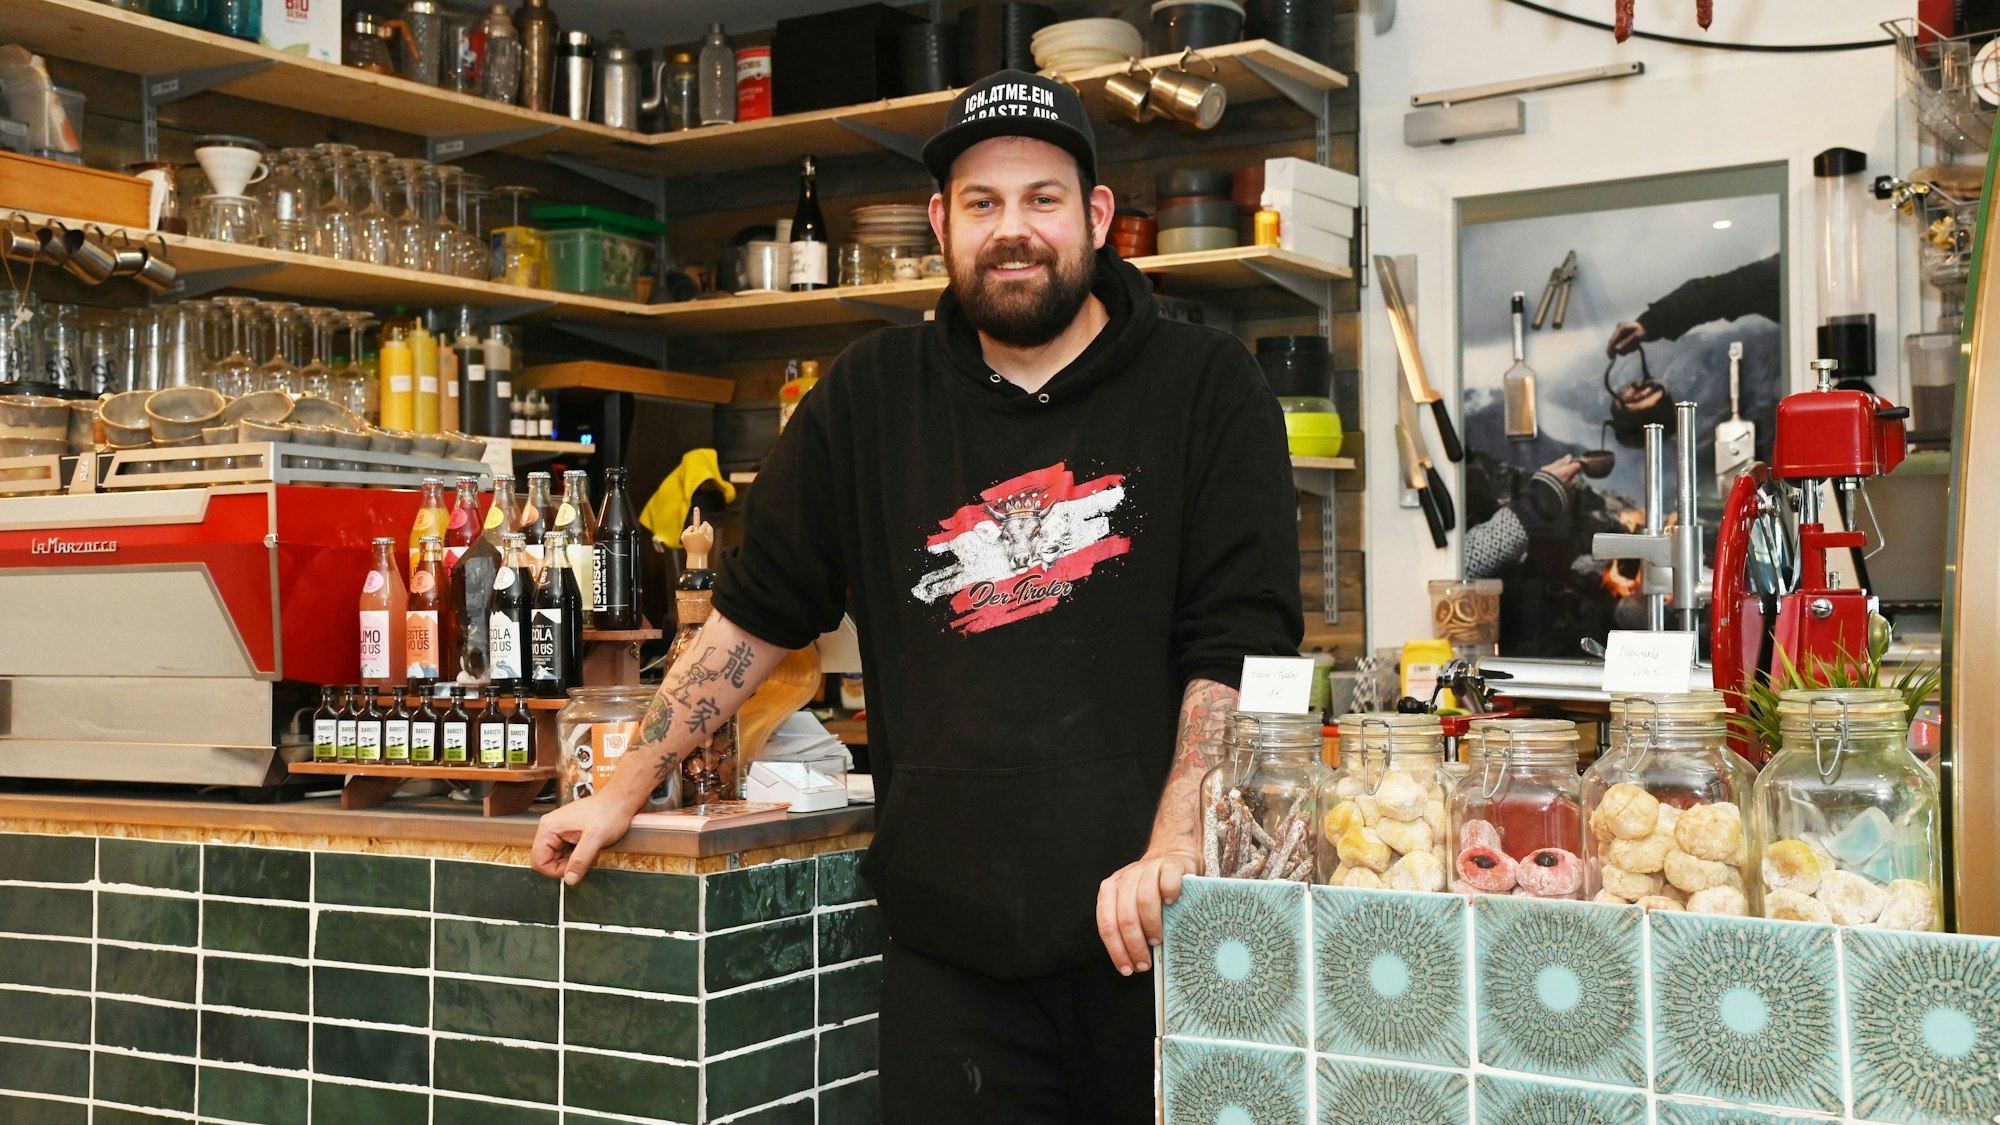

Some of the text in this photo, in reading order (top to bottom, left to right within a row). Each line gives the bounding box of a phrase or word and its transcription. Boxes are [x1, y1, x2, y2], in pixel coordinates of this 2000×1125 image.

[969, 574, 1073, 609] Der Tiroler
[532, 628, 553, 641] COLA
